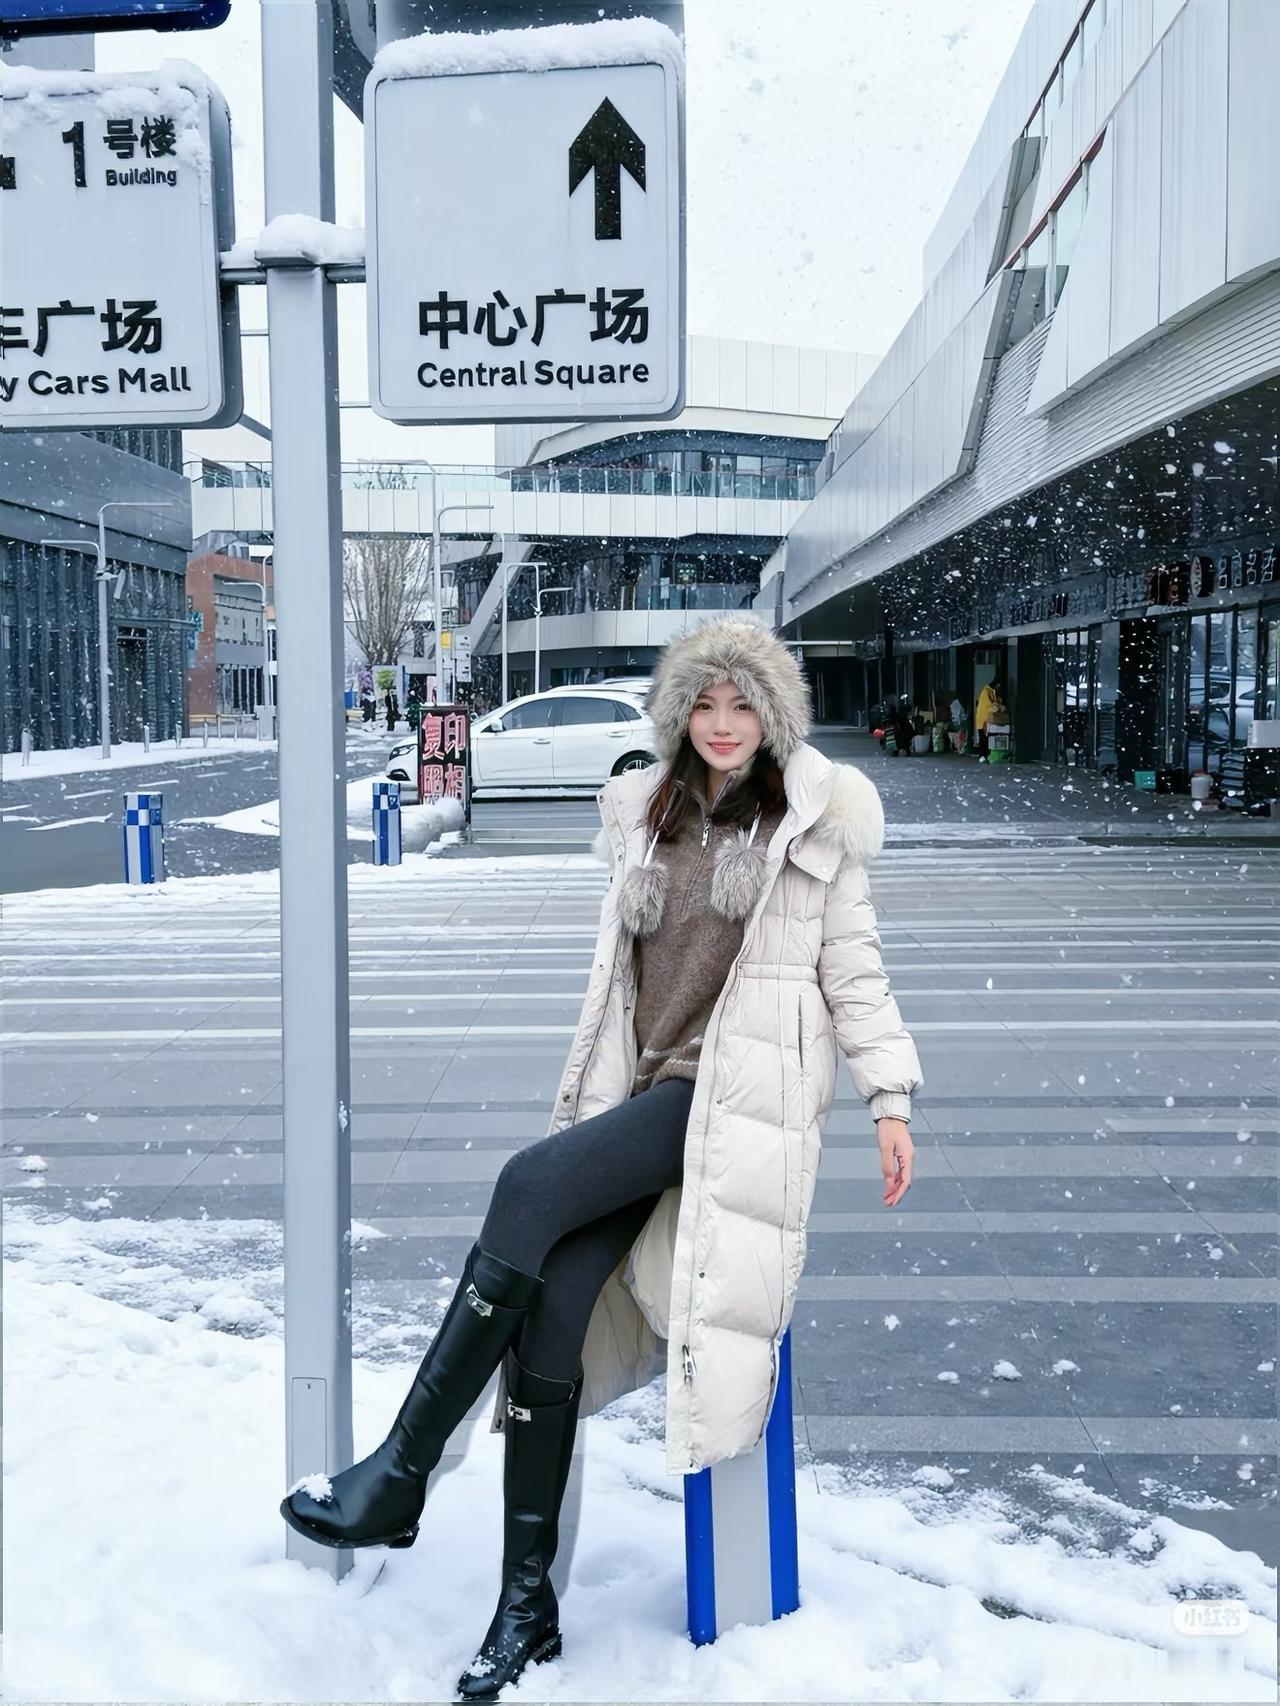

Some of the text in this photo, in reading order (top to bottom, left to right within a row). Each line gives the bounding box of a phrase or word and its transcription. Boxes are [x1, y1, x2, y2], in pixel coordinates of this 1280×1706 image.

[62, 115, 177, 187] 1 号楼
[106, 168, 177, 186] Building
[419, 287, 649, 350] 中心广场
[28, 370, 109, 396] Cars
[118, 366, 191, 393] Mall
[417, 360, 649, 390] Central Square
[422, 712, 466, 760] 复印
[423, 763, 466, 810] 照相
